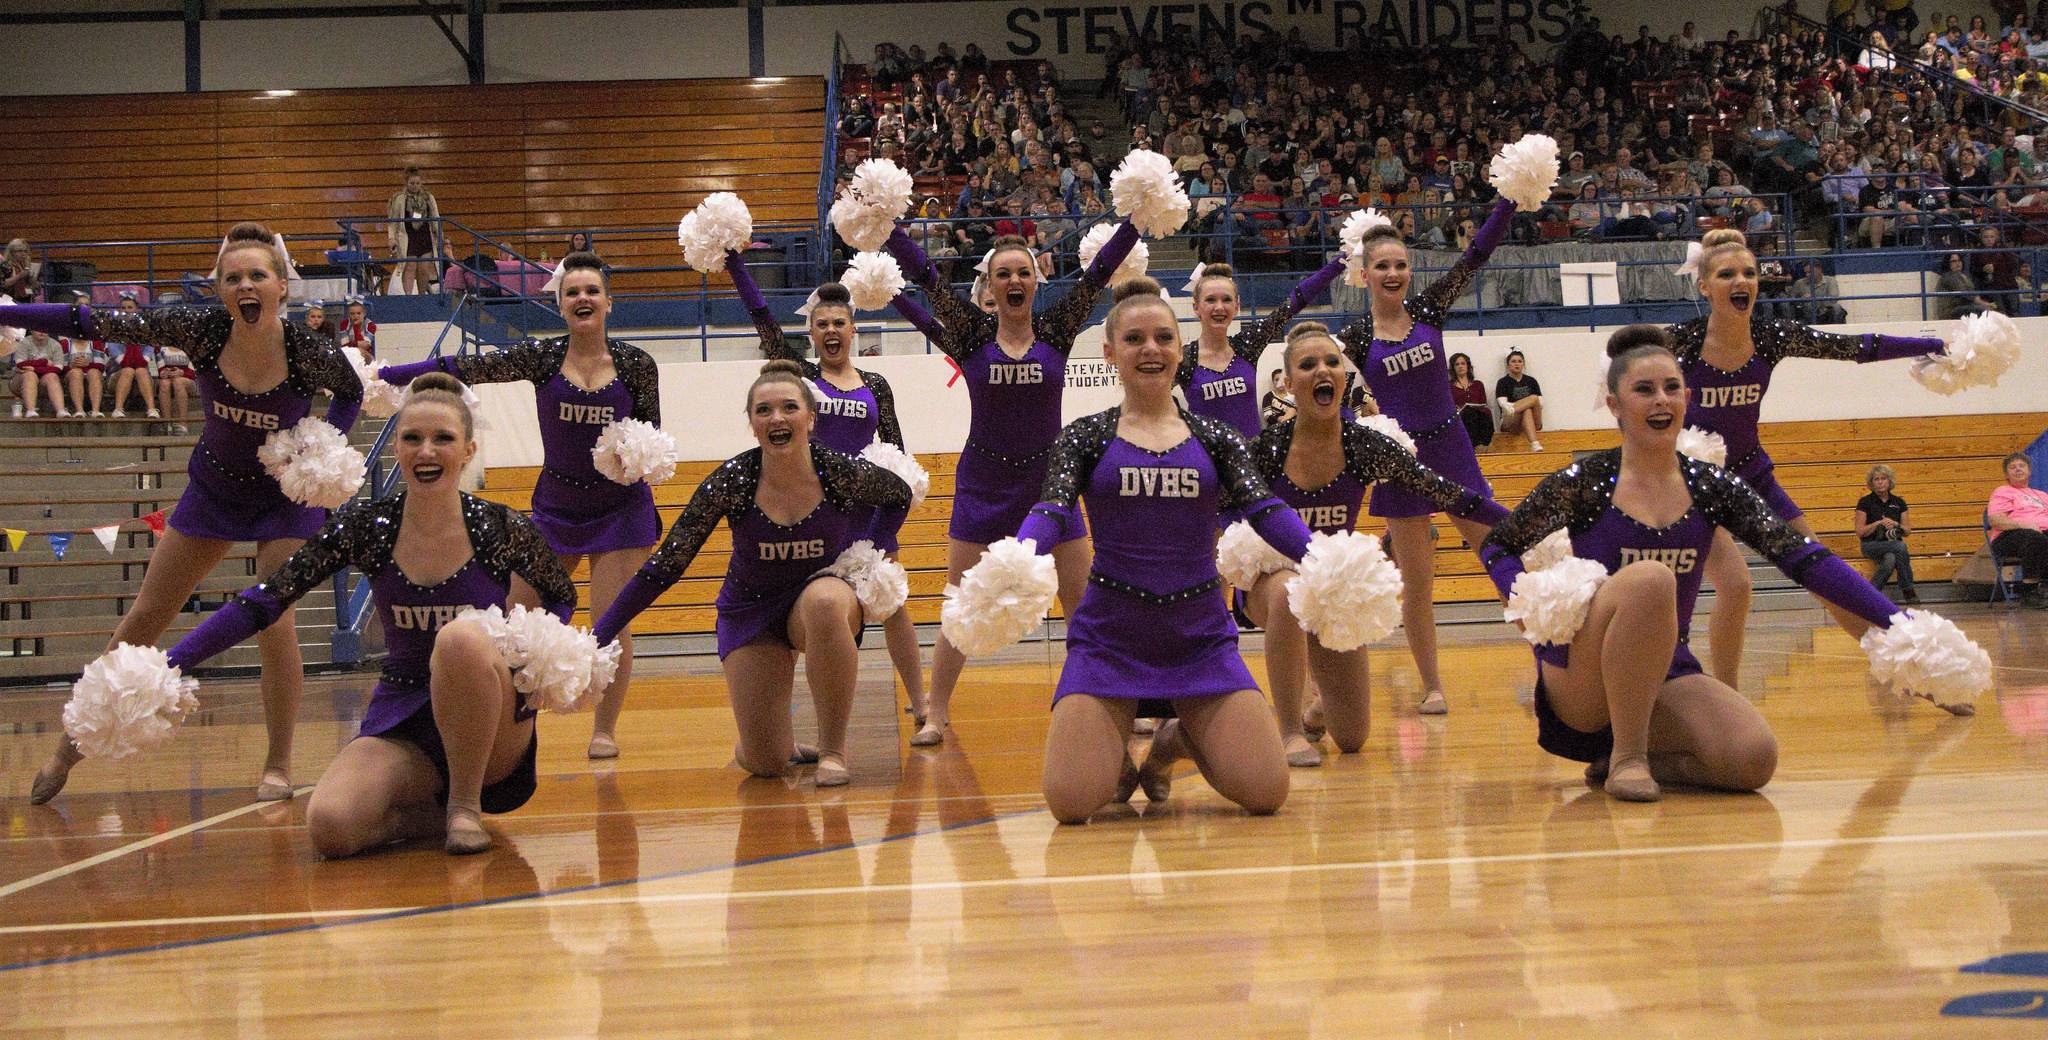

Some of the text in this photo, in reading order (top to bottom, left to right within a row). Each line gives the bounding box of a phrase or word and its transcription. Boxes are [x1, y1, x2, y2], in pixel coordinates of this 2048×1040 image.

[1006, 2, 1275, 56] STEVENS
[1334, 0, 1571, 48] RAIDERS
[1382, 341, 1435, 376] DVHS
[988, 363, 1043, 385] DVHS
[1063, 376, 1123, 388] TUDENT
[1201, 376, 1247, 400] DVHS
[1700, 383, 1761, 408] DVHS
[212, 400, 280, 430] DVHS
[559, 401, 615, 425] DVHS
[819, 397, 867, 418] DVHS
[1119, 466, 1200, 498] DVHS
[1294, 504, 1347, 528] VHS
[758, 539, 825, 561] DVHS
[391, 603, 474, 631] DVH
